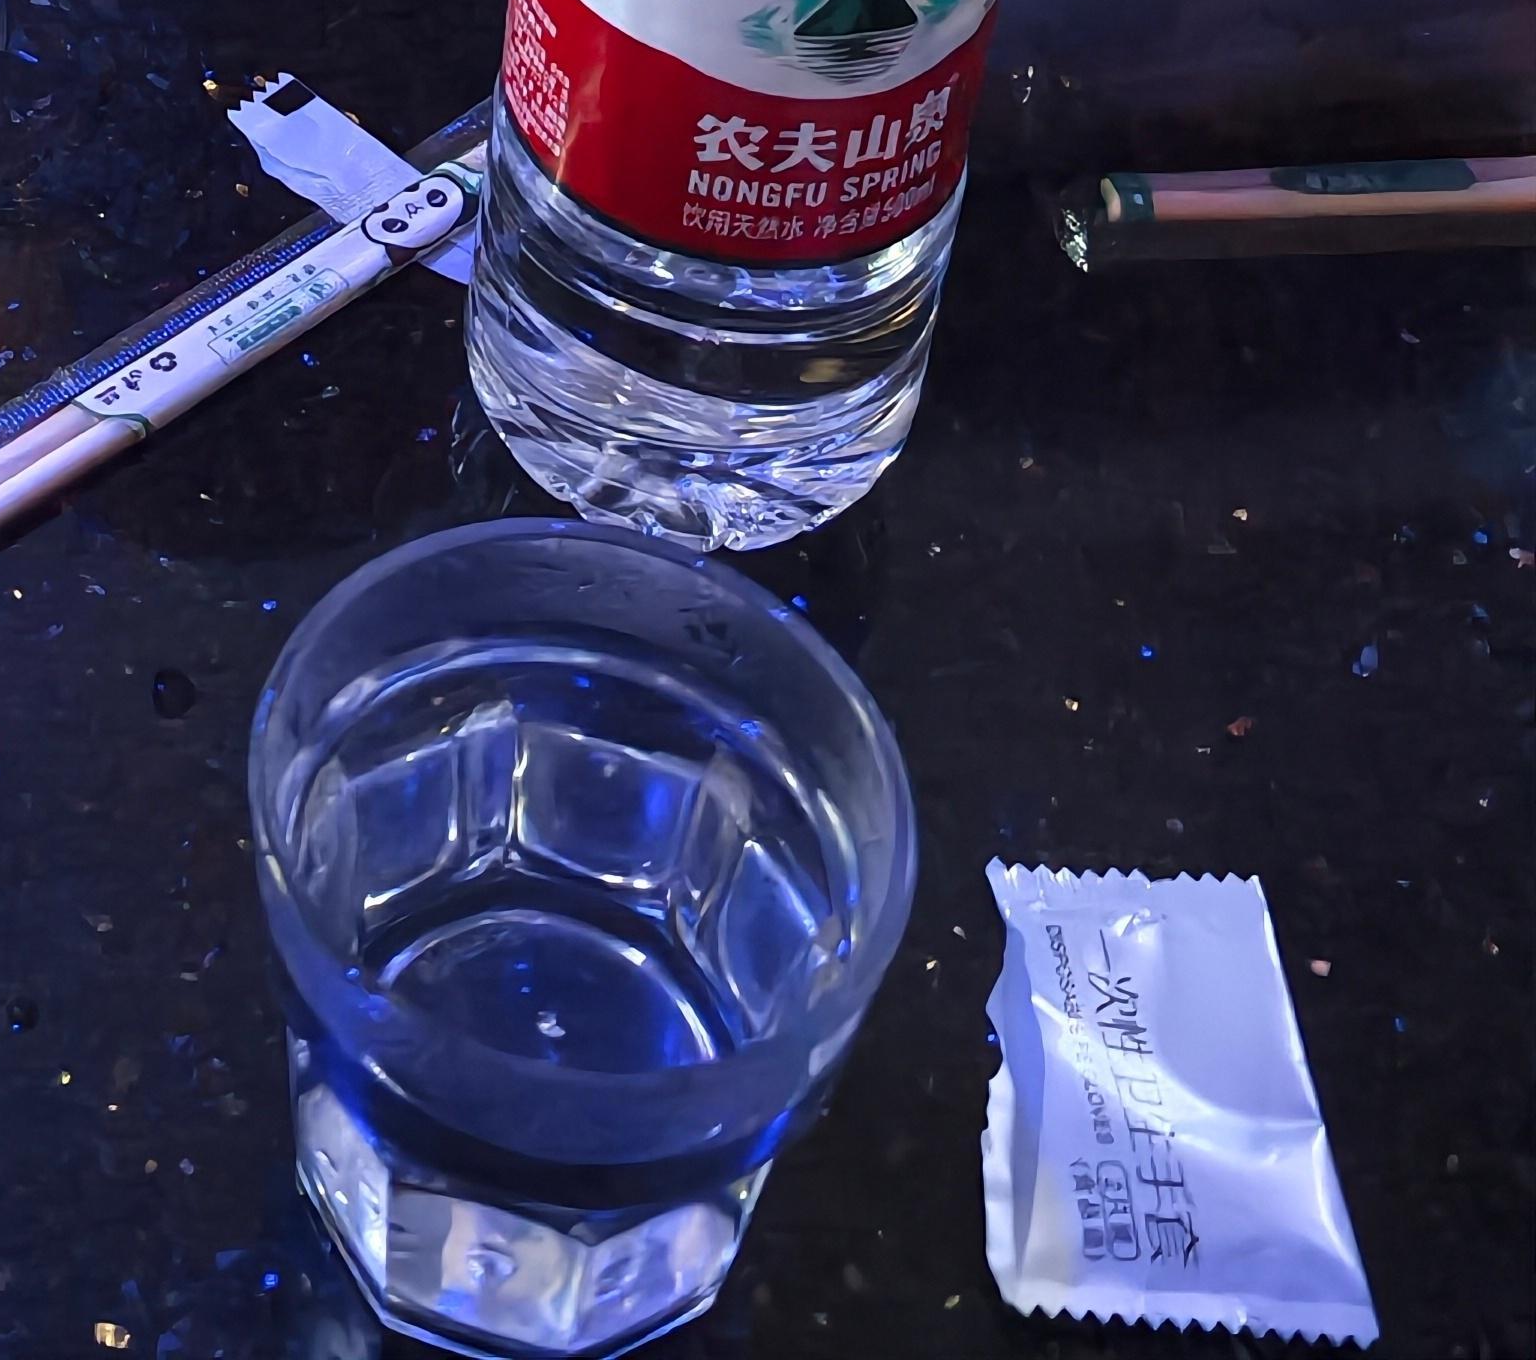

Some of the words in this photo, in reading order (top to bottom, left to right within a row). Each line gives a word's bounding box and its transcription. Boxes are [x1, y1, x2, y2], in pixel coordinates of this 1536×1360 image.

[693, 75, 957, 173] 农夫山泉
[688, 169, 828, 209] NONGFU
[839, 140, 942, 202] SPRING
[1088, 929, 1200, 1268] 一次性卫生手套
